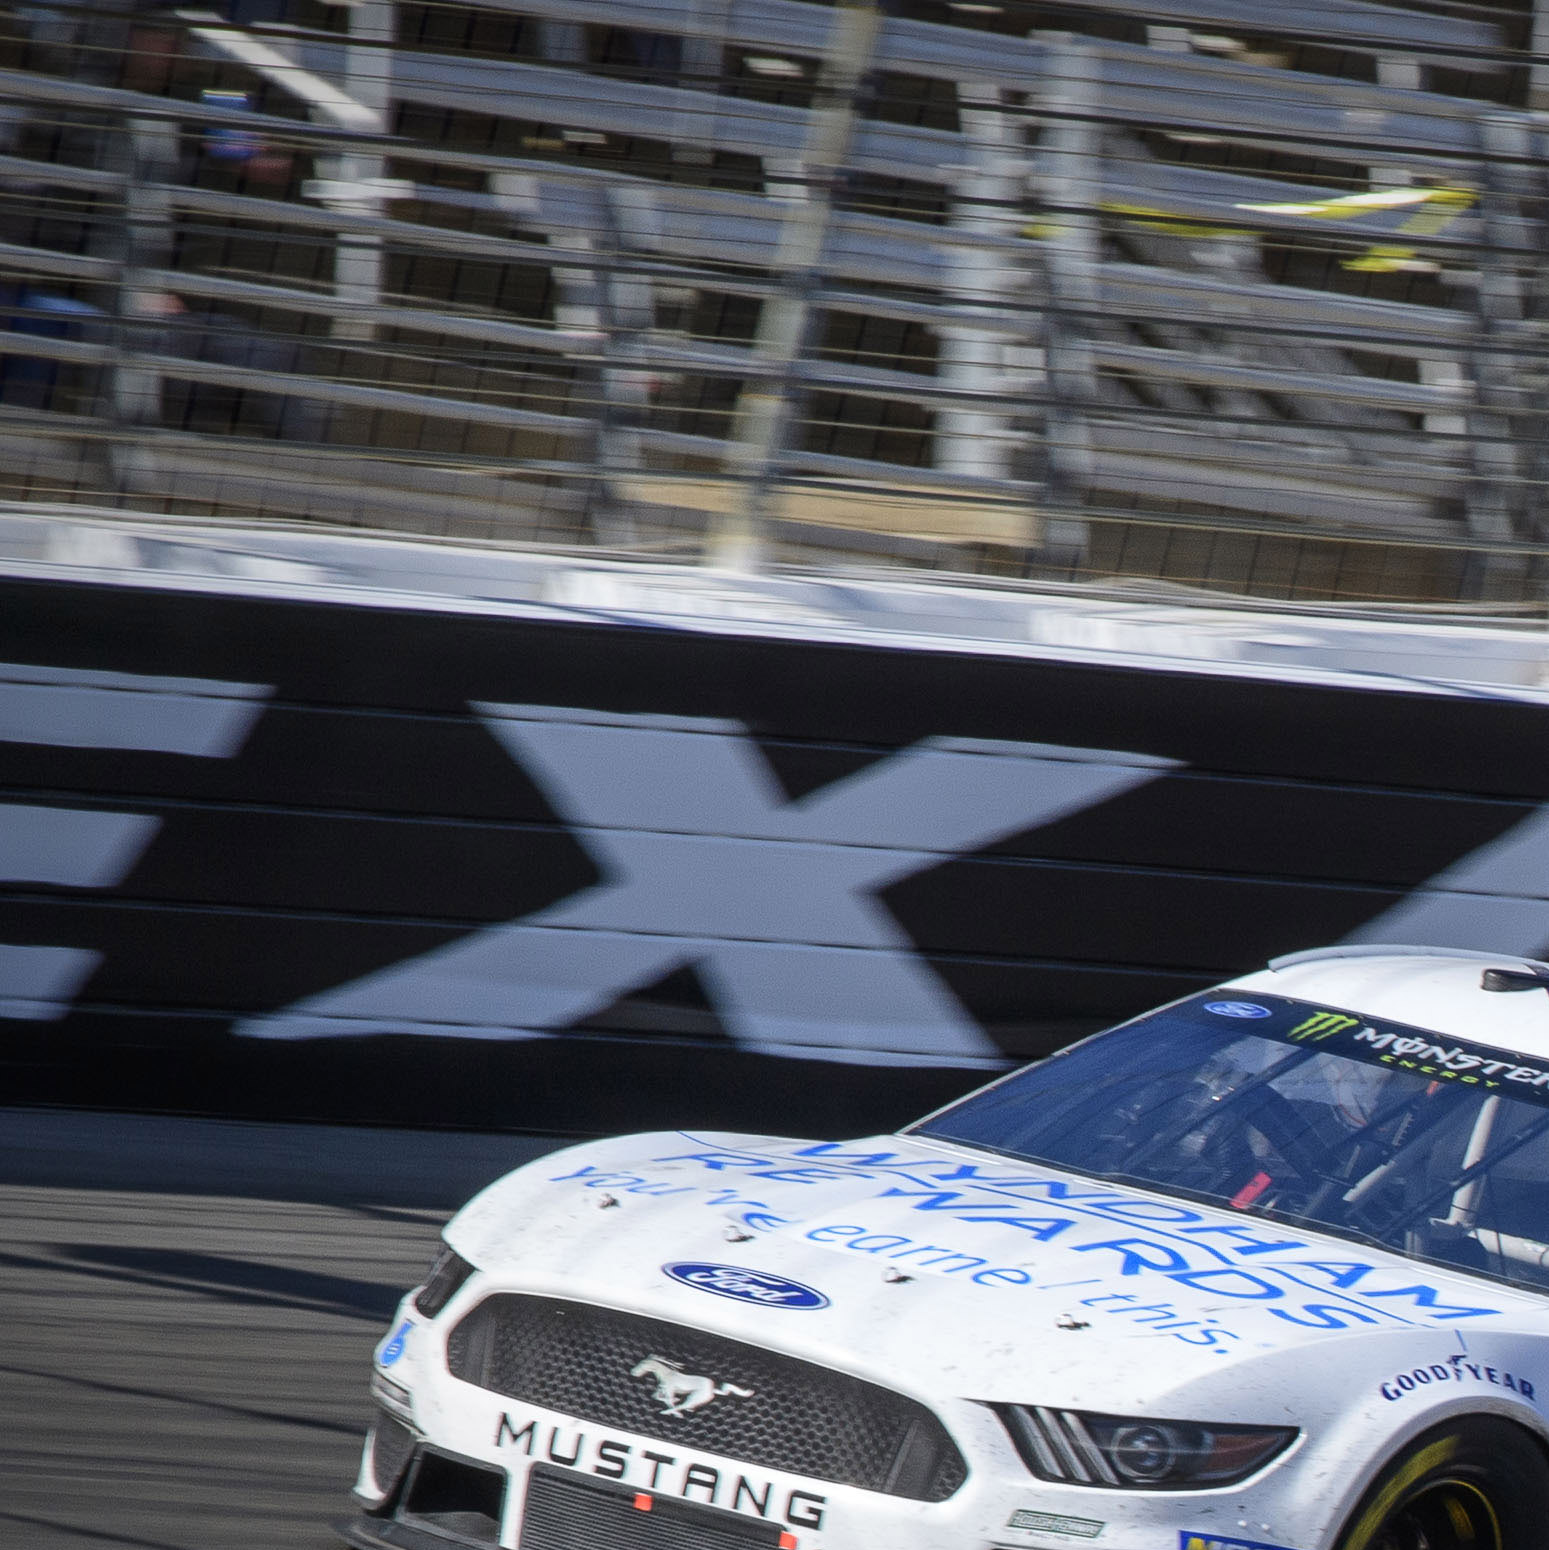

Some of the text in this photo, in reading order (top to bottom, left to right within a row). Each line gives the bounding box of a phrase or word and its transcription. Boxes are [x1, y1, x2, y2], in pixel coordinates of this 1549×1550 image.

[1379, 1055, 1499, 1088] ENERGY
[652, 1153, 1379, 1329] REWARDS
[793, 1143, 1504, 1320] WYNDHAM
[1380, 1359, 1536, 1401] GOODYEAR
[494, 1411, 827, 1530] MUSTANG
